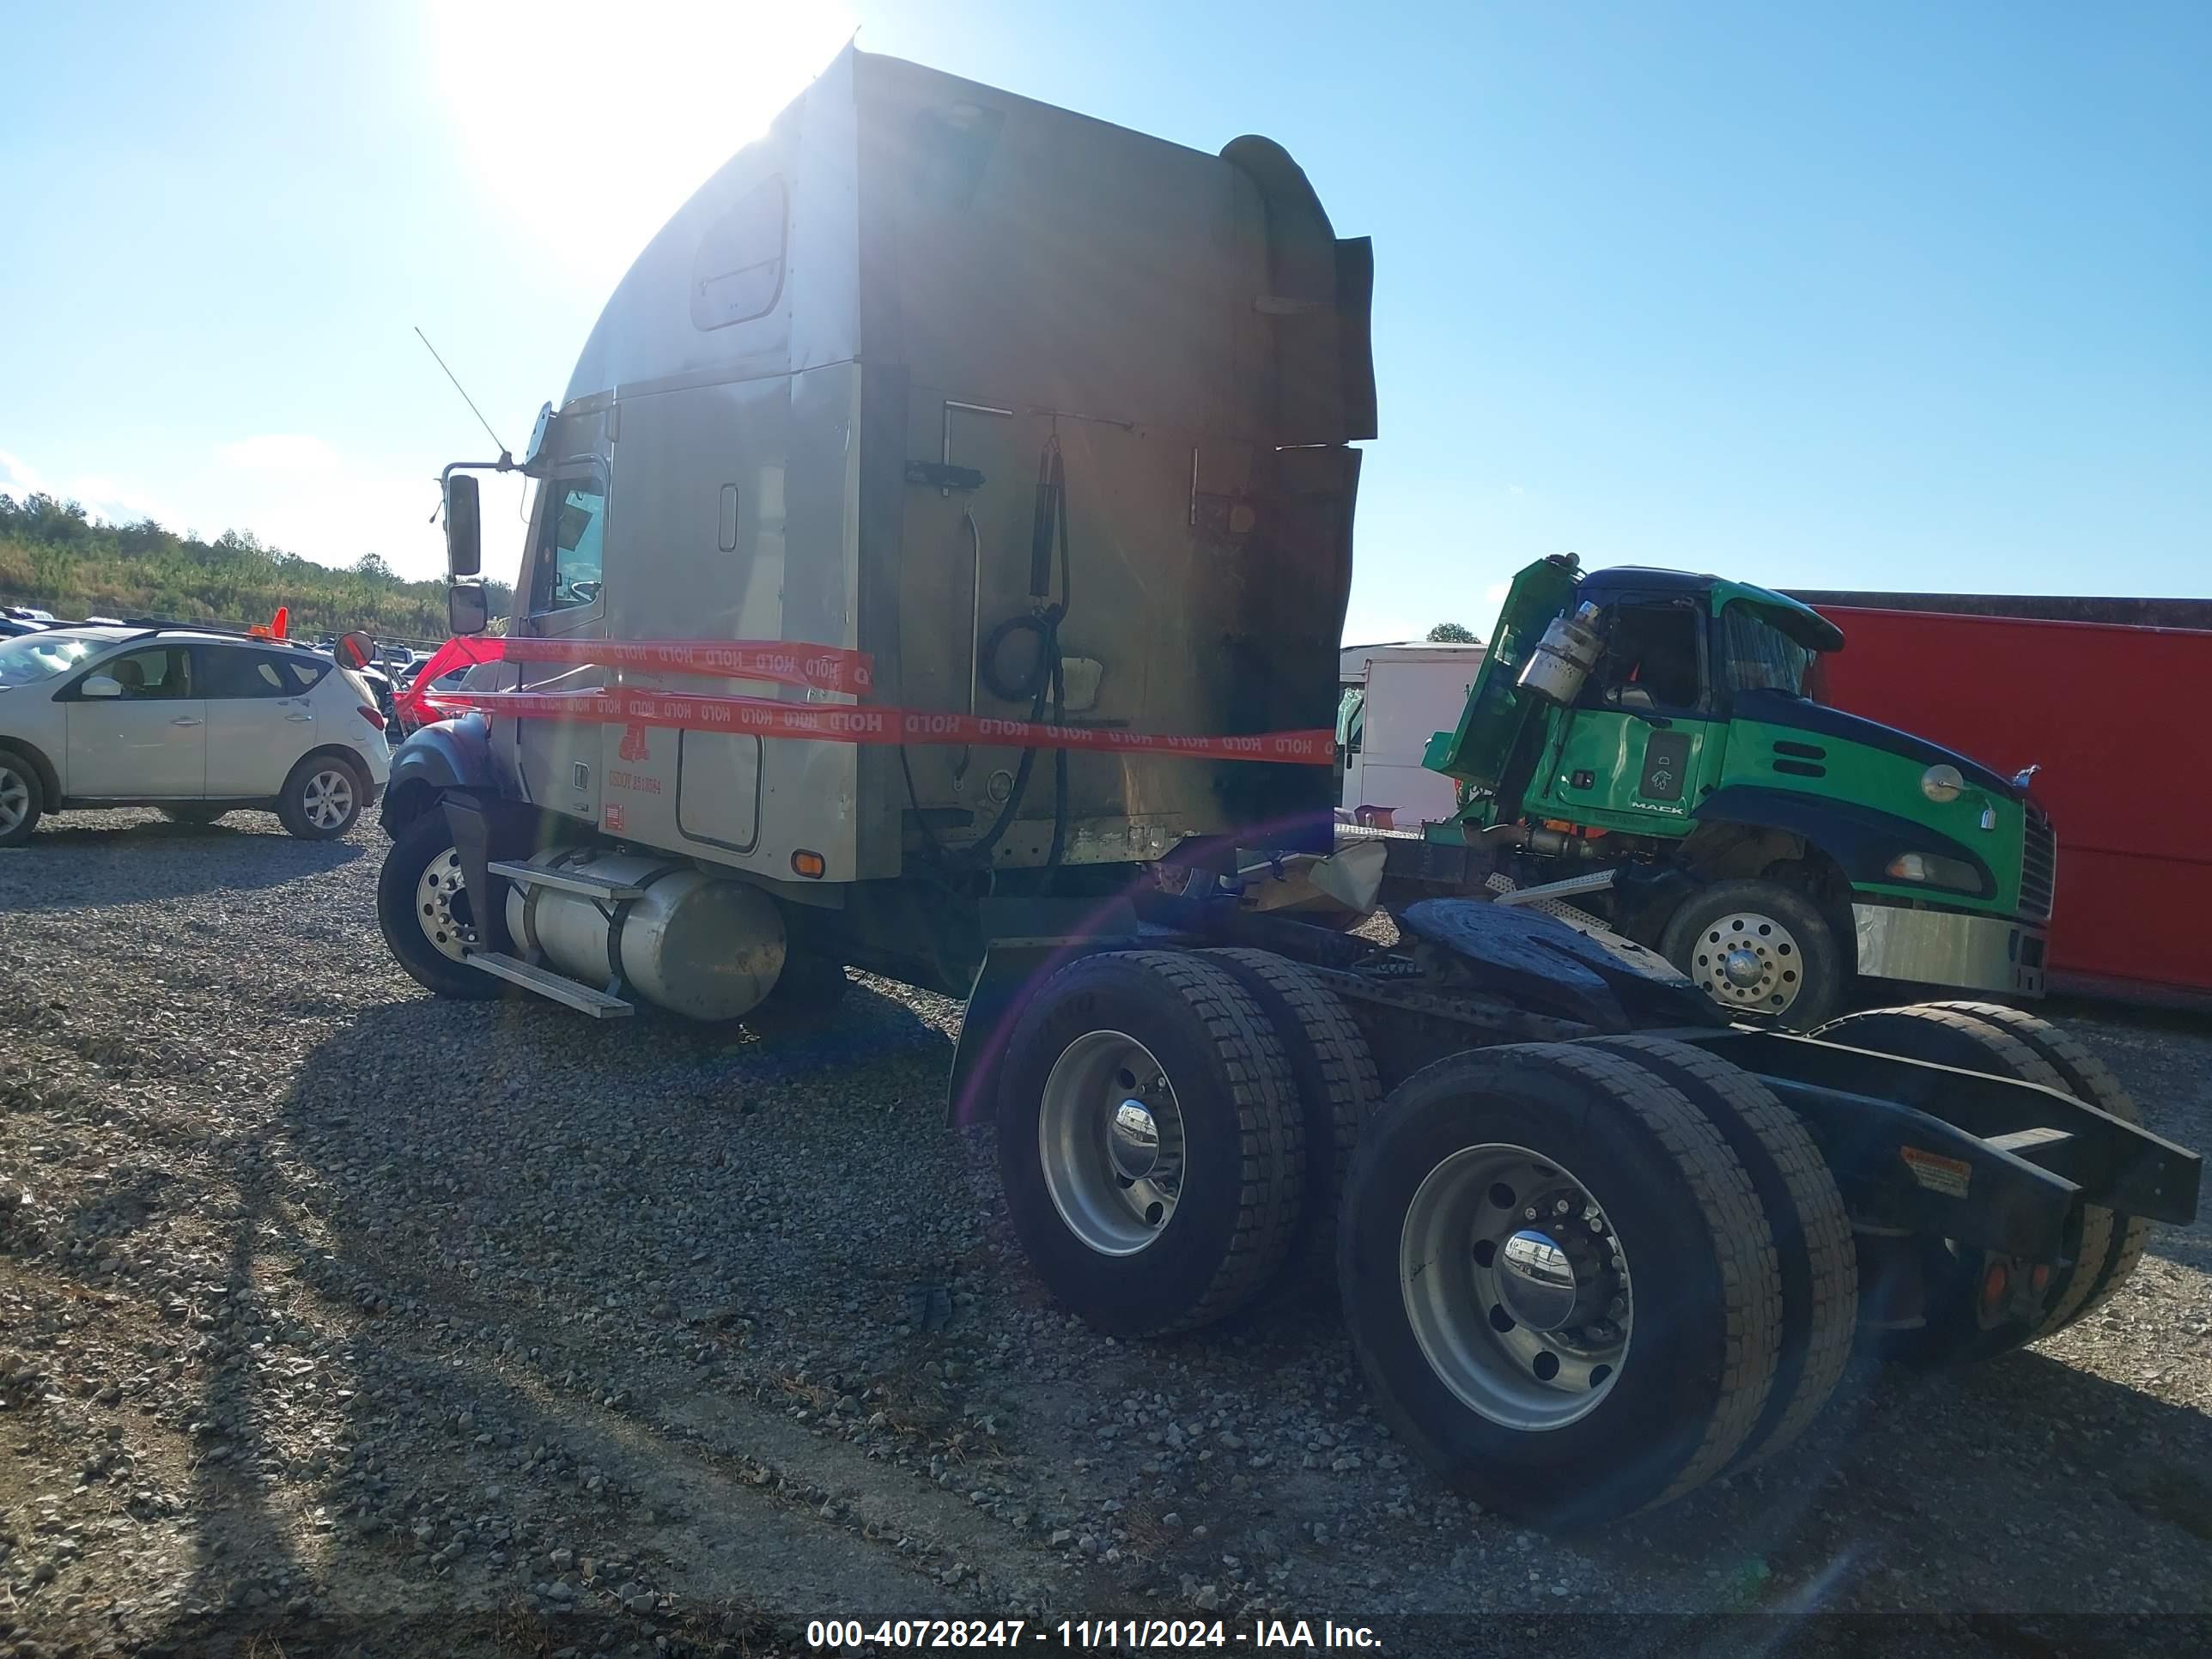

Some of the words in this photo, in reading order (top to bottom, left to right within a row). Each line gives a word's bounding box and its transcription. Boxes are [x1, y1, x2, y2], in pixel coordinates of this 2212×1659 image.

[658, 646, 694, 664] HOLD
[705, 650, 743, 668] HOLD
[757, 653, 795, 672] HOLD
[805, 659, 838, 680] HOLD
[598, 700, 622, 714] HOLD
[629, 701, 655, 715] HOLD
[665, 702, 692, 719] HOLD
[701, 706, 730, 721] HOLD
[741, 708, 773, 725] HOLD
[784, 712, 817, 728] HOLD
[830, 714, 883, 732] HOLD
[904, 714, 960, 733] HOLD
[979, 718, 1030, 736] HOLD
[1222, 736, 1262, 752] HOLD
[1276, 738, 1312, 755] HOLD
[1632, 802, 1684, 815] MACK
